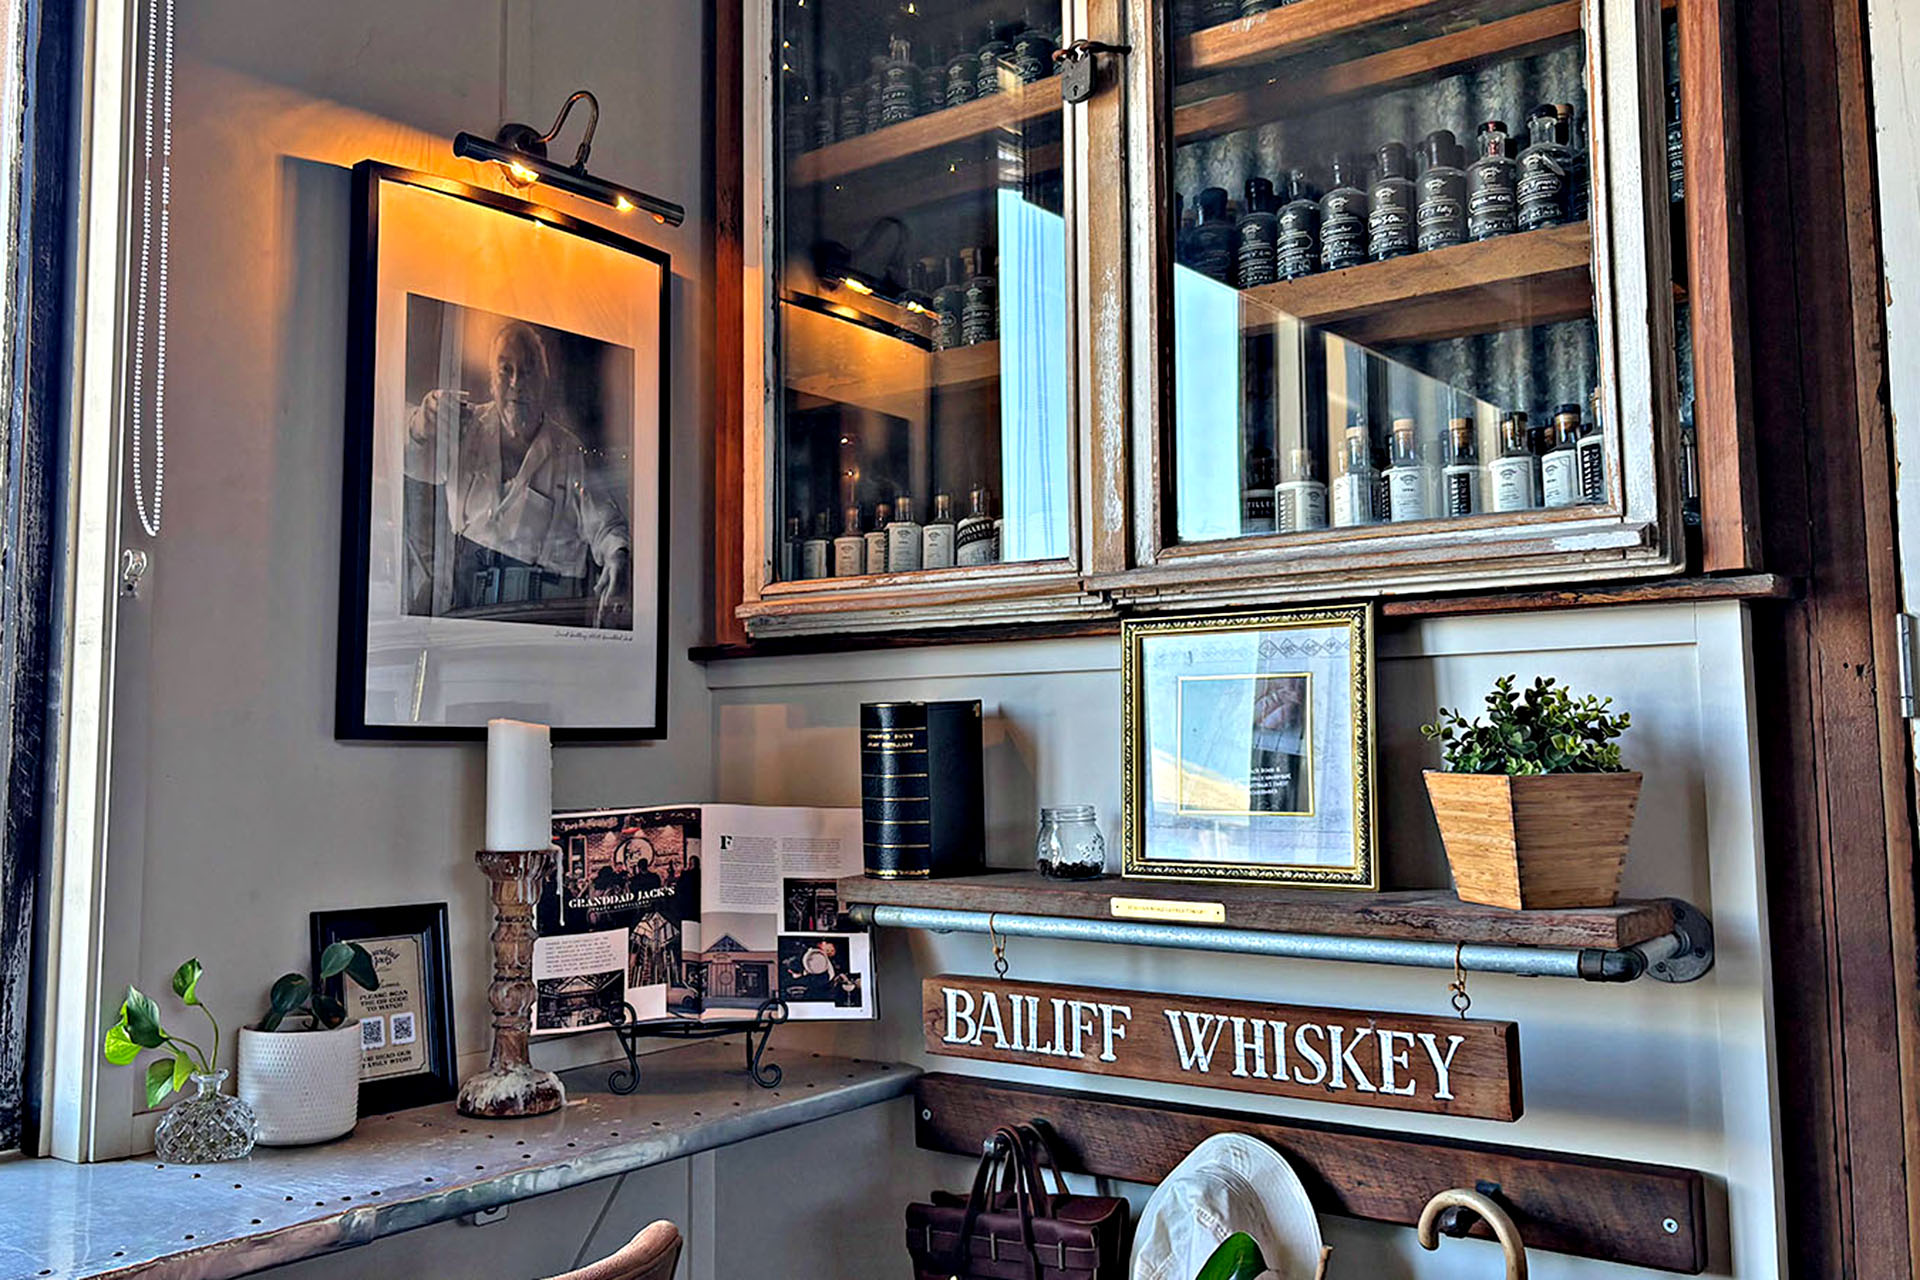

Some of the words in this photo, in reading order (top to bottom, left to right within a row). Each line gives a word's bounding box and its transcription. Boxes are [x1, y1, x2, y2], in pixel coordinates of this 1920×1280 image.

[568, 893, 635, 908] GRANDDAD
[637, 886, 676, 901] JACK'S
[941, 986, 1134, 1062] BAILIFF
[1163, 1008, 1465, 1102] WHISKEY
